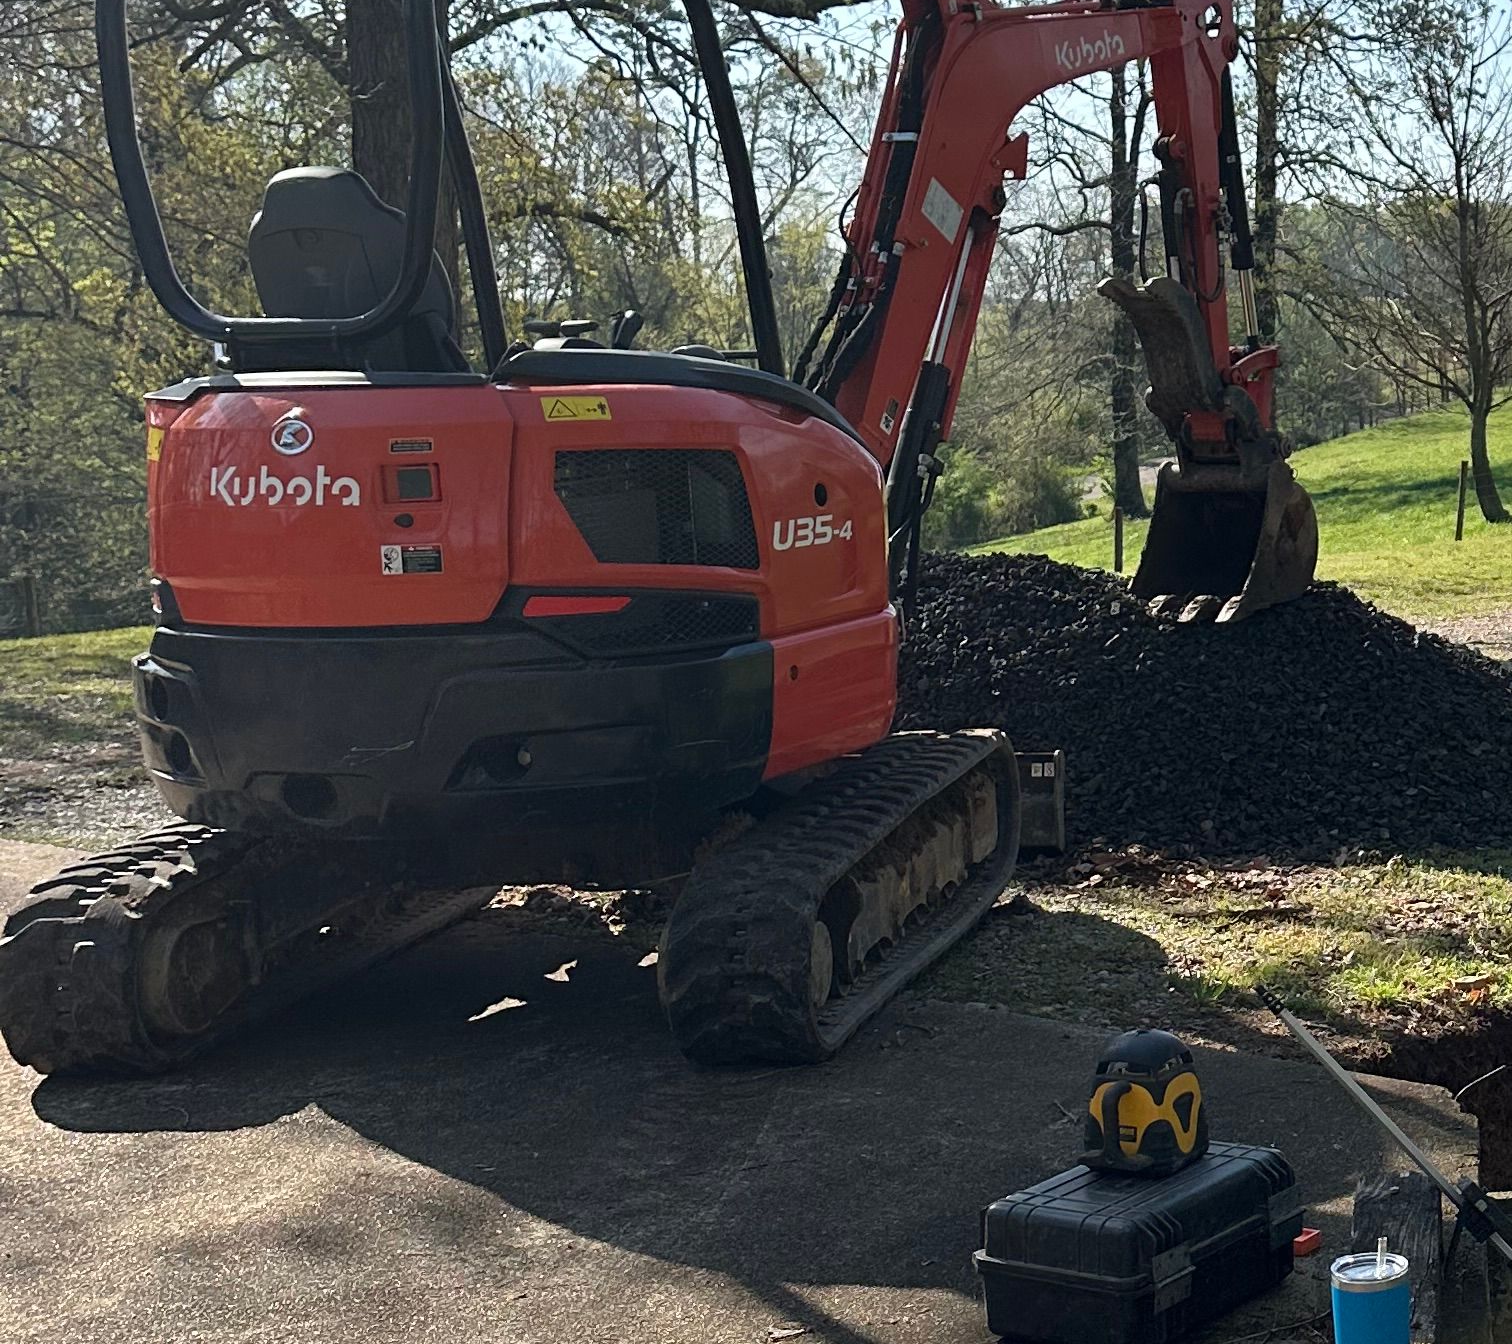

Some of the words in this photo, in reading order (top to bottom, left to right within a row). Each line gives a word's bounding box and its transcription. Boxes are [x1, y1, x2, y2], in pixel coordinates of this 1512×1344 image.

[1055, 29, 1125, 70] Kubota
[210, 465, 361, 506] Kubota
[773, 514, 853, 551] U35-4
